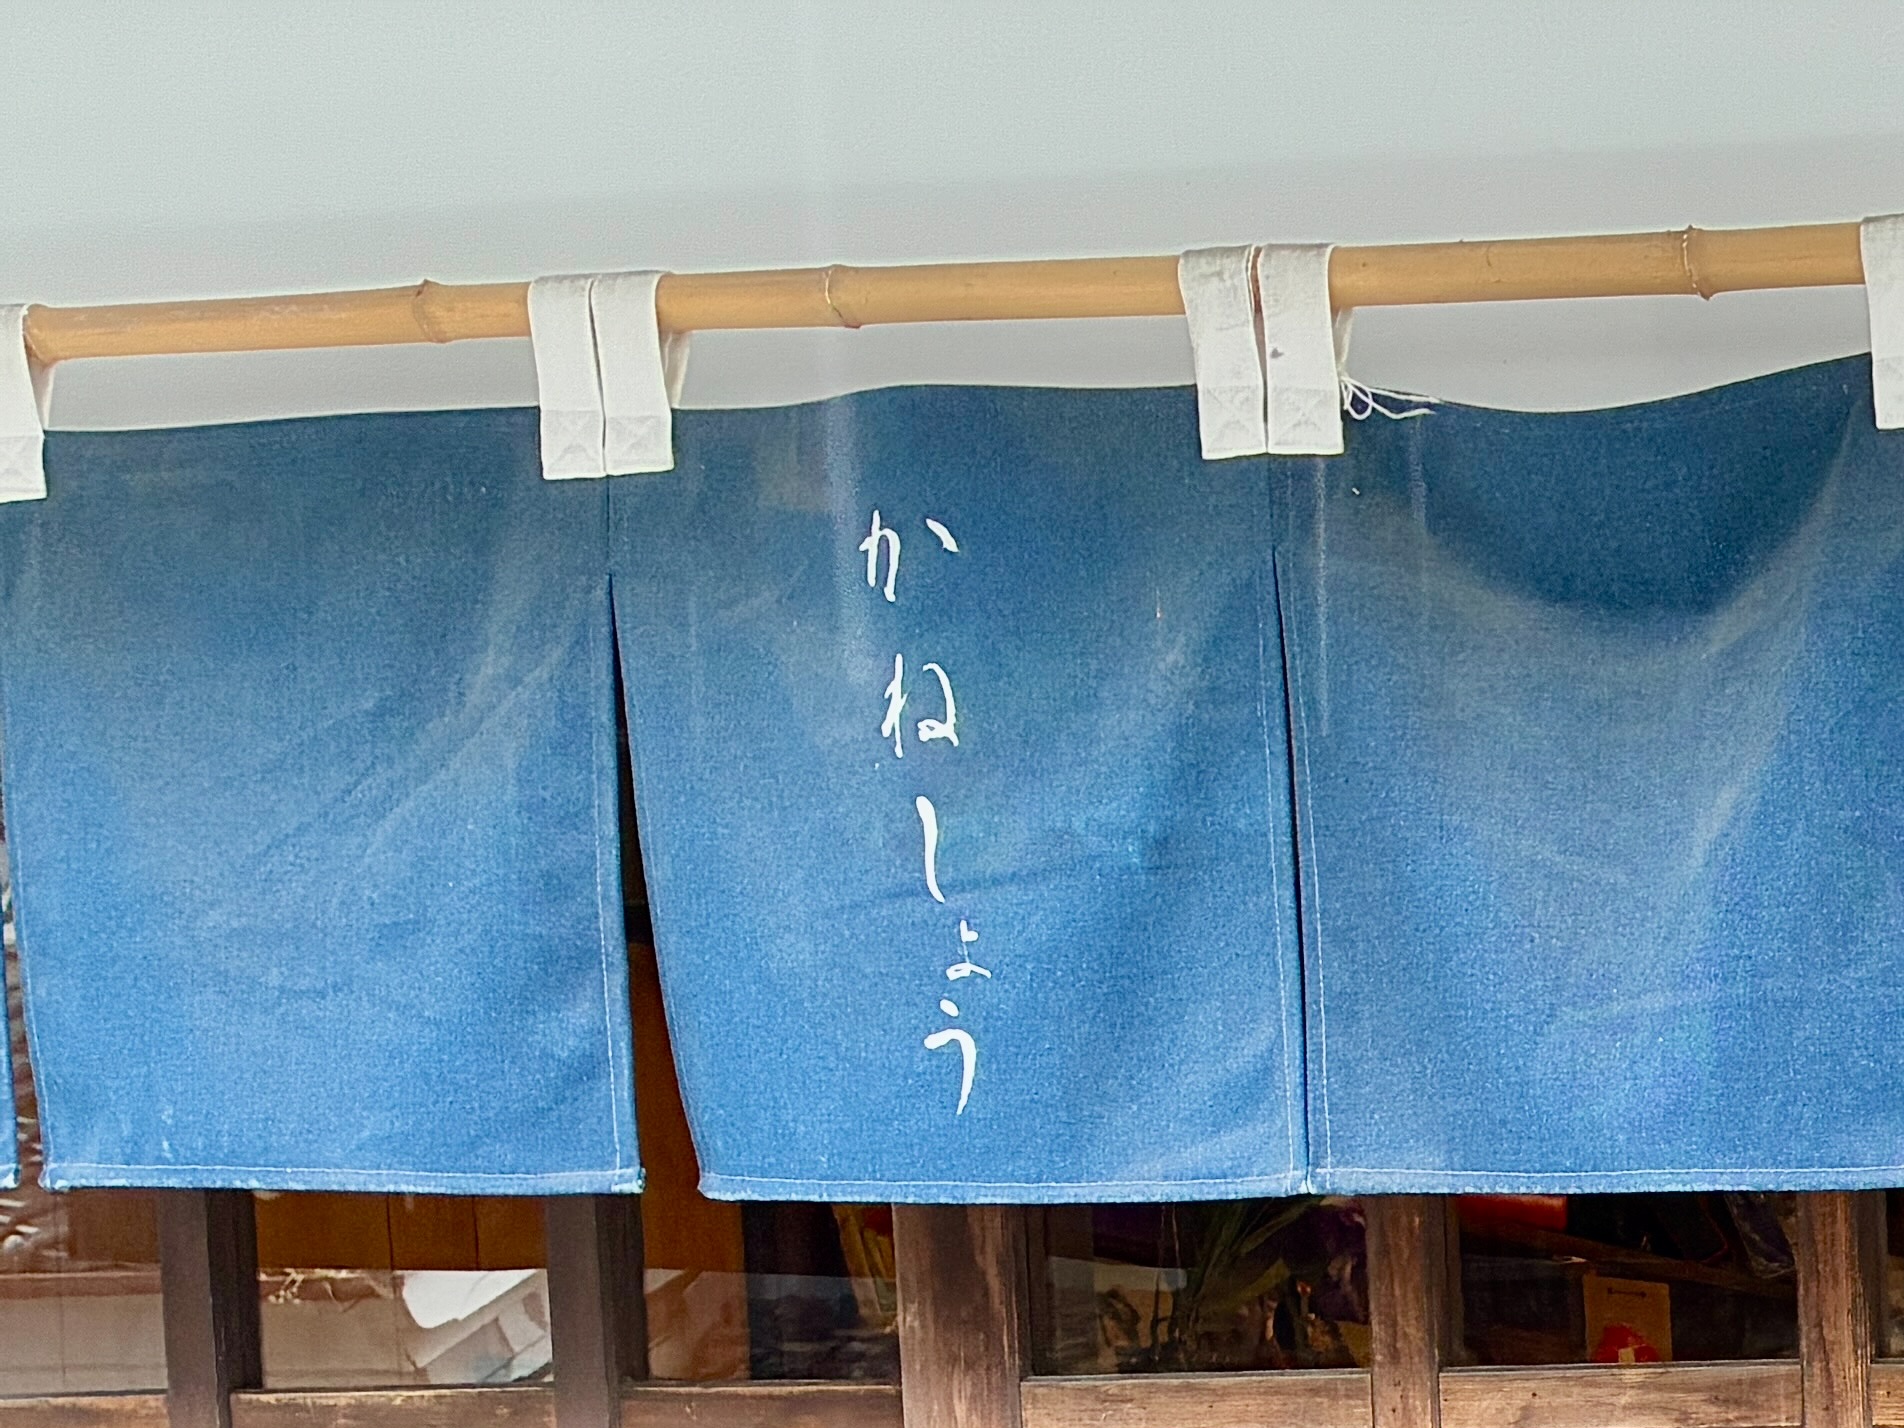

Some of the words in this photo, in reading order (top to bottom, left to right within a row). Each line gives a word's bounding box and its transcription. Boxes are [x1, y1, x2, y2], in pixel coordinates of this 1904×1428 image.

[859, 510, 991, 1114] かねしょう
